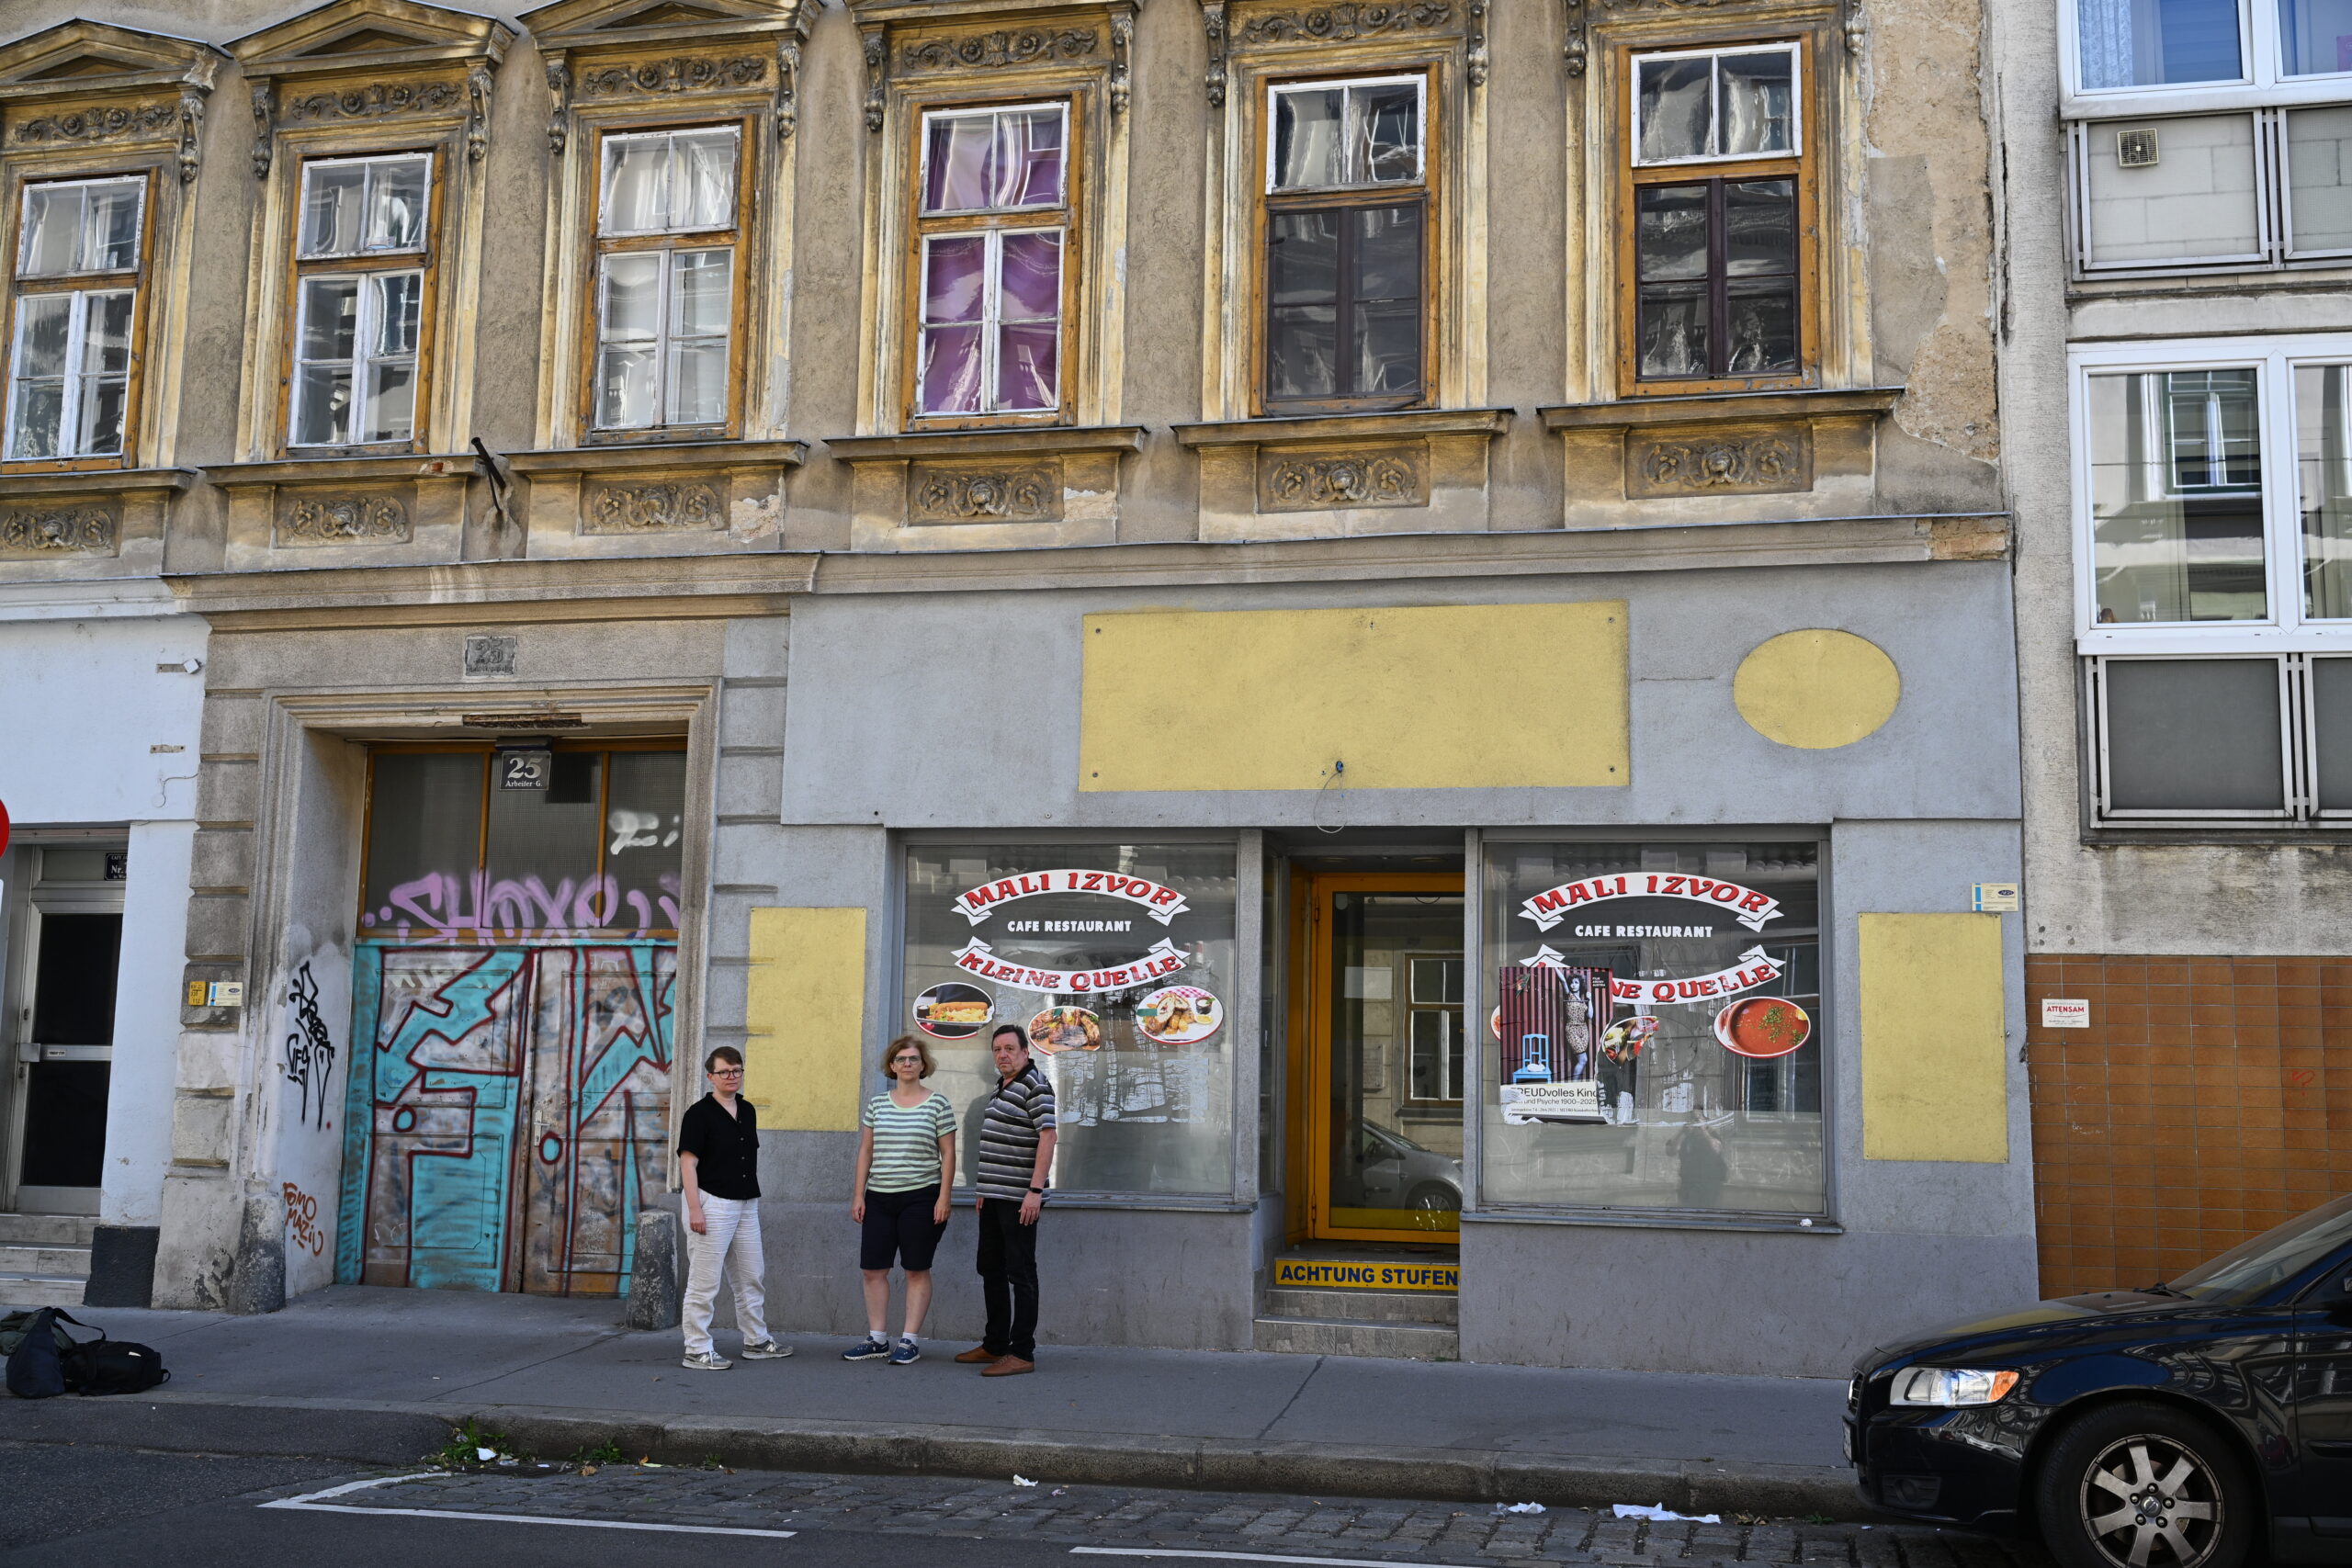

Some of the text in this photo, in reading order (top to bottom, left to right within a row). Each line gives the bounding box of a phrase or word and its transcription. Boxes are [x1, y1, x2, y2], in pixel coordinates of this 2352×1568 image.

[507, 757, 543, 779] 25
[964, 872, 1178, 908] MALI IZVOR
[1532, 874, 1770, 914] MALI IZVOR
[1007, 920, 1132, 932] CAFE RESTAURANT
[1575, 925, 1713, 938] CAFE RESTAURANT
[959, 953, 1182, 992] KLEINE QUELLE
[1653, 964, 1777, 1002] QUELLE
[1537, 1098, 1559, 1106] Psyche
[1281, 1265, 1458, 1286] ACHTUNG STUFEN
